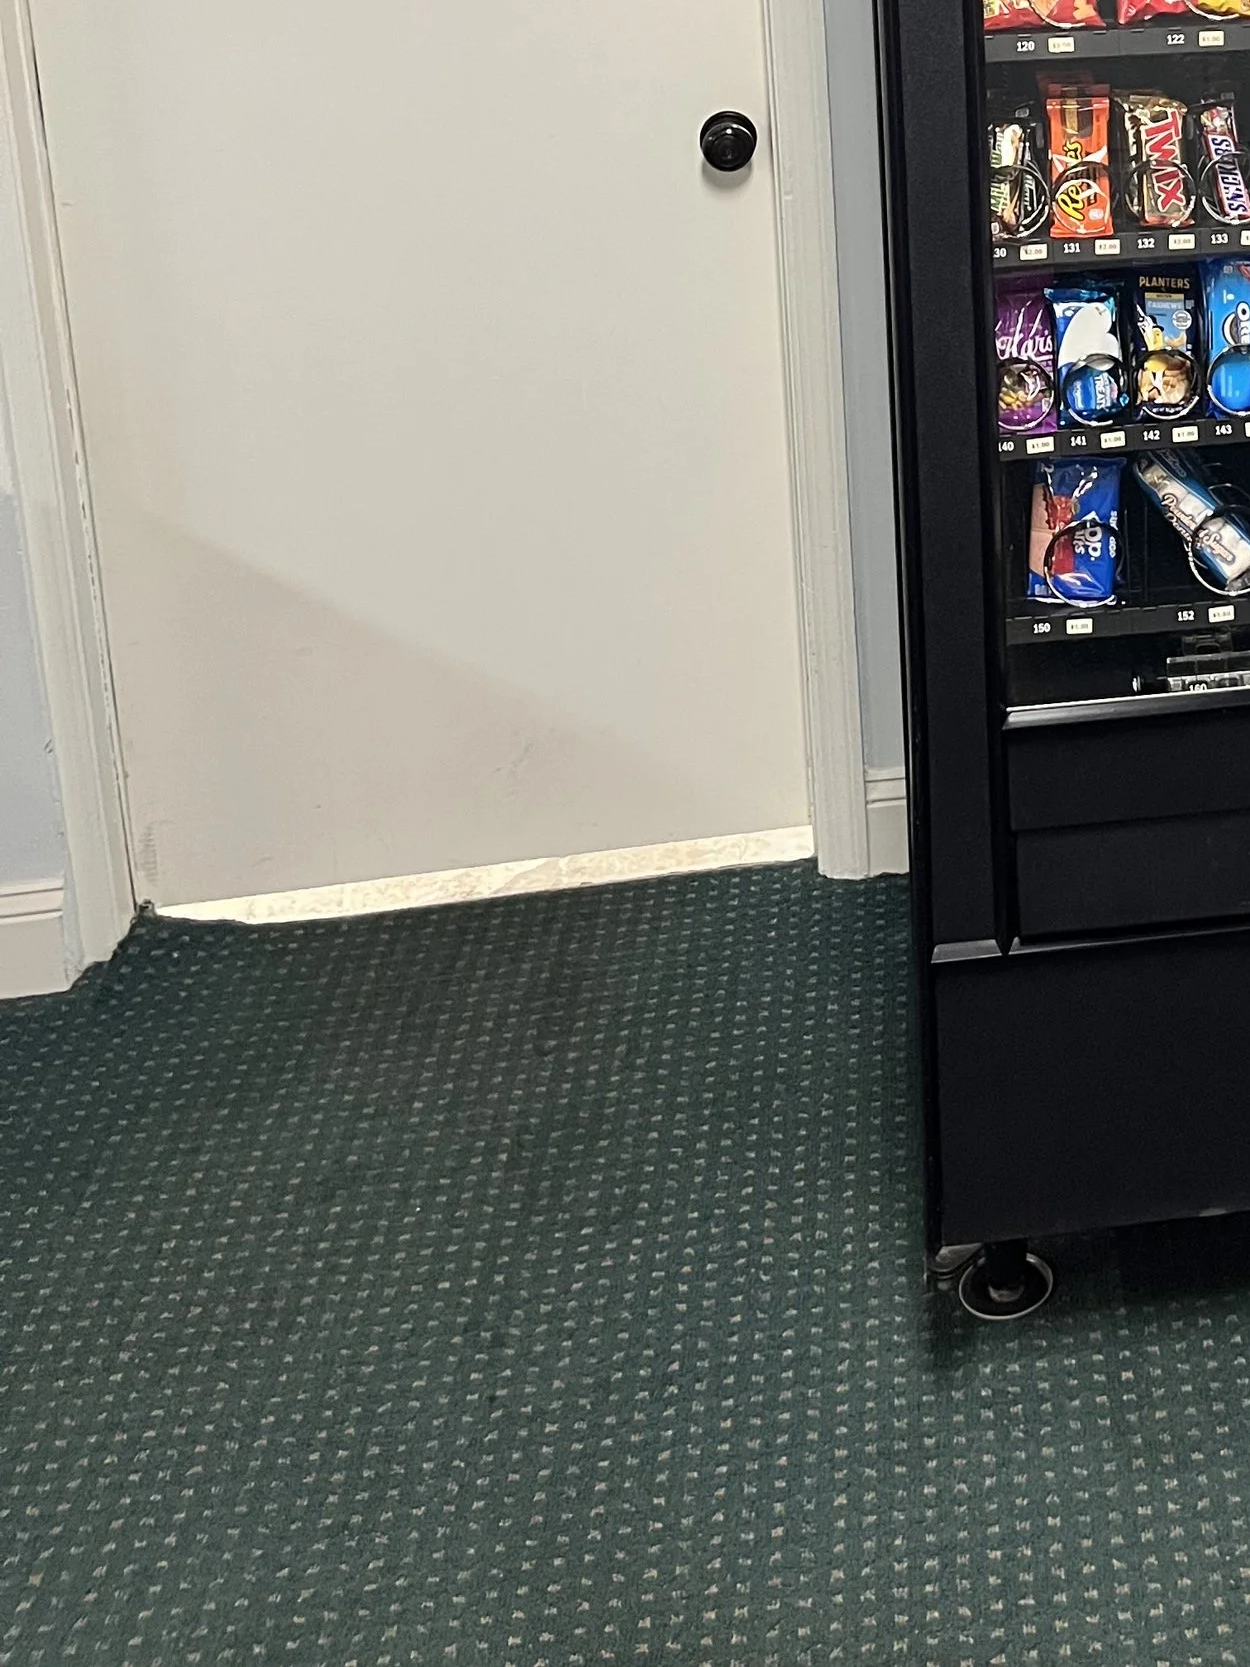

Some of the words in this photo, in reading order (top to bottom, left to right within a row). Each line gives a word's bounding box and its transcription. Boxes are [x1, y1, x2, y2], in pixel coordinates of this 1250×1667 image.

[1167, 34, 1185, 45] 122
[1017, 41, 1035, 52] 120
[1137, 238, 1155, 249] 132
[1210, 233, 1229, 244] 133
[993, 247, 1007, 258] 30
[1063, 243, 1081, 254] 131
[1139, 276, 1191, 289] PLANTERS
[1094, 376, 1106, 410] TREATS
[1215, 424, 1233, 435] 143
[1070, 435, 1087, 447] 141
[1143, 430, 1161, 441] 142
[998, 441, 1015, 452] 140
[1177, 610, 1195, 622] 152
[1033, 622, 1051, 634] 150
